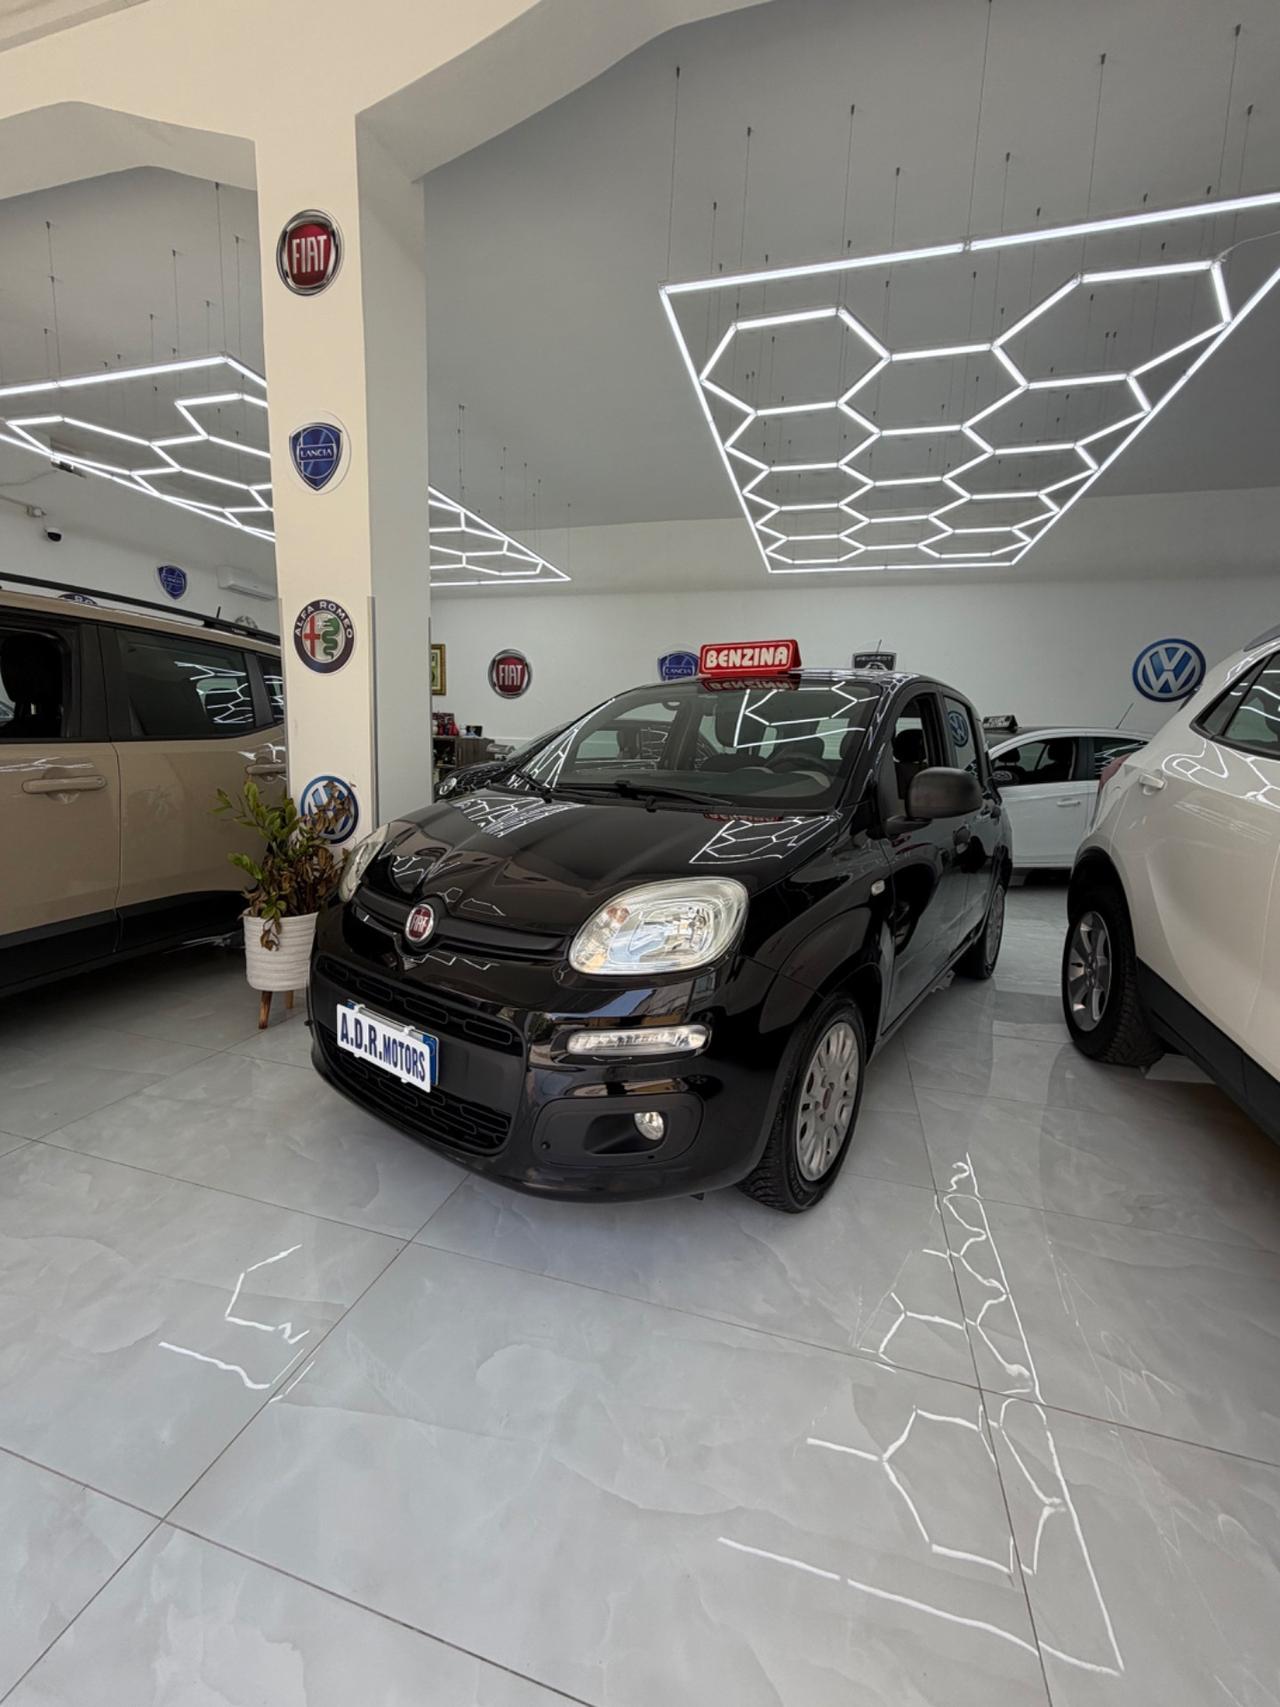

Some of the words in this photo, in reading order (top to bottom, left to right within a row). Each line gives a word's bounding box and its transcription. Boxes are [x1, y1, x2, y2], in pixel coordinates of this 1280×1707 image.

[291, 235, 328, 274] FIAT
[300, 448, 332, 458] LANCIA
[295, 605, 315, 637] ALFA
[319, 601, 353, 639] ROMEO
[705, 641, 789, 669] BENZINA
[499, 664, 523, 686] FIAT
